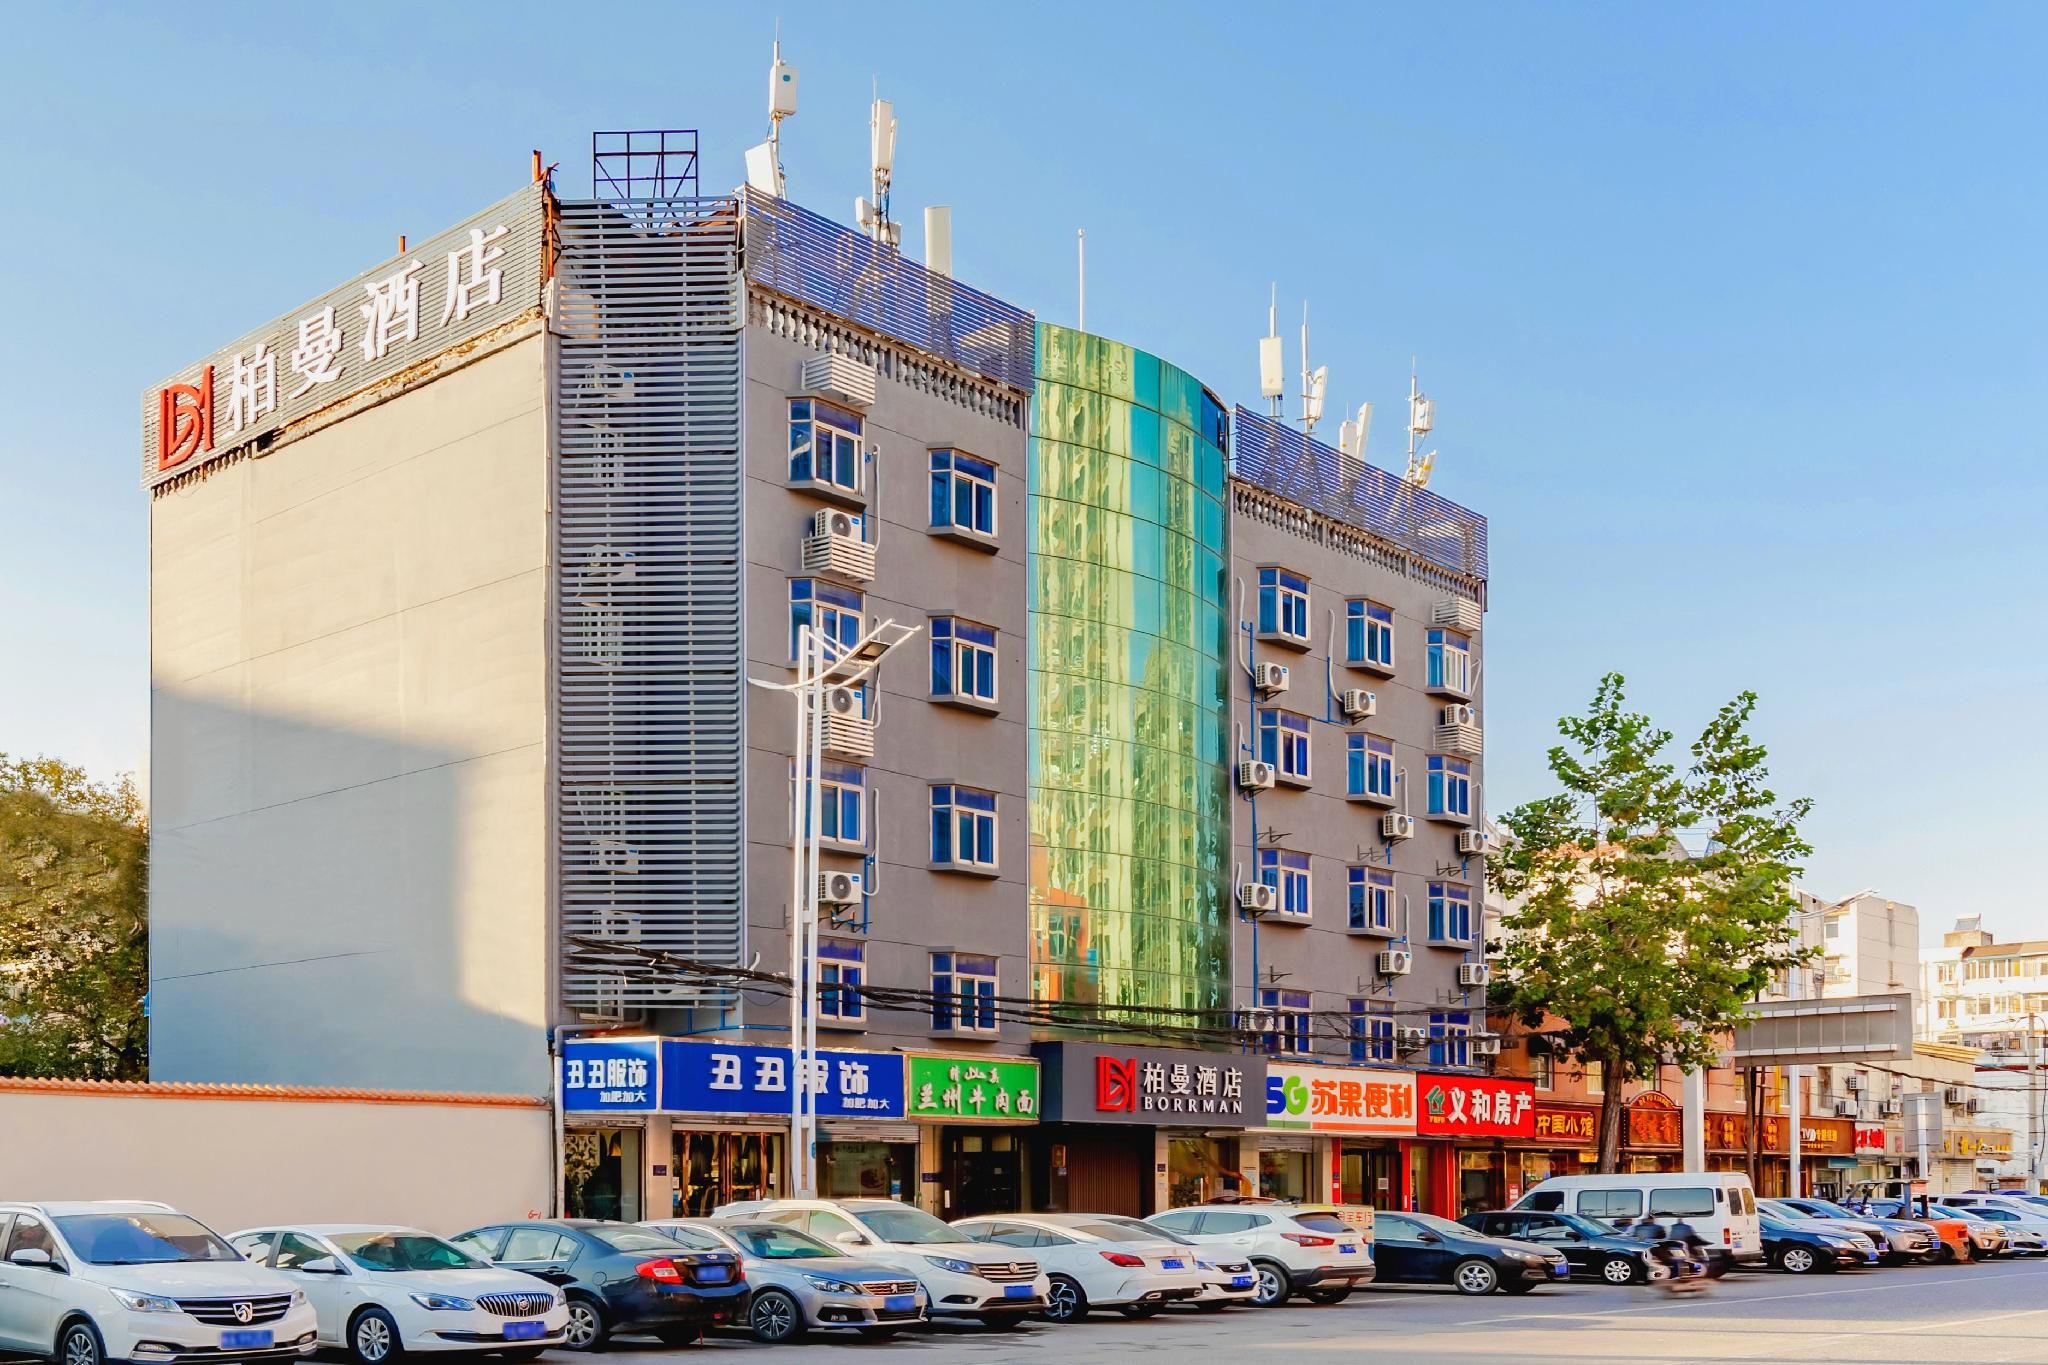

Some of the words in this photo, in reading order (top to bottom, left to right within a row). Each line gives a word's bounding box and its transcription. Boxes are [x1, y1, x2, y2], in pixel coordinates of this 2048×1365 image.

[222, 225, 511, 438] 柏曼酒店
[566, 1058, 647, 1089] 丑丑服饰
[1143, 1062, 1243, 1098] 柏曼酒店
[600, 1089, 647, 1103] 加肥加大
[842, 1097, 891, 1110] 加肥加大
[917, 1083, 1034, 1115] 兰州牛肉面
[1144, 1096, 1243, 1114] BORRMAN
[1312, 1079, 1412, 1118] 苏果便利
[1447, 1087, 1532, 1126] 义和房产
[1537, 1114, 1594, 1137] 中国小馆
